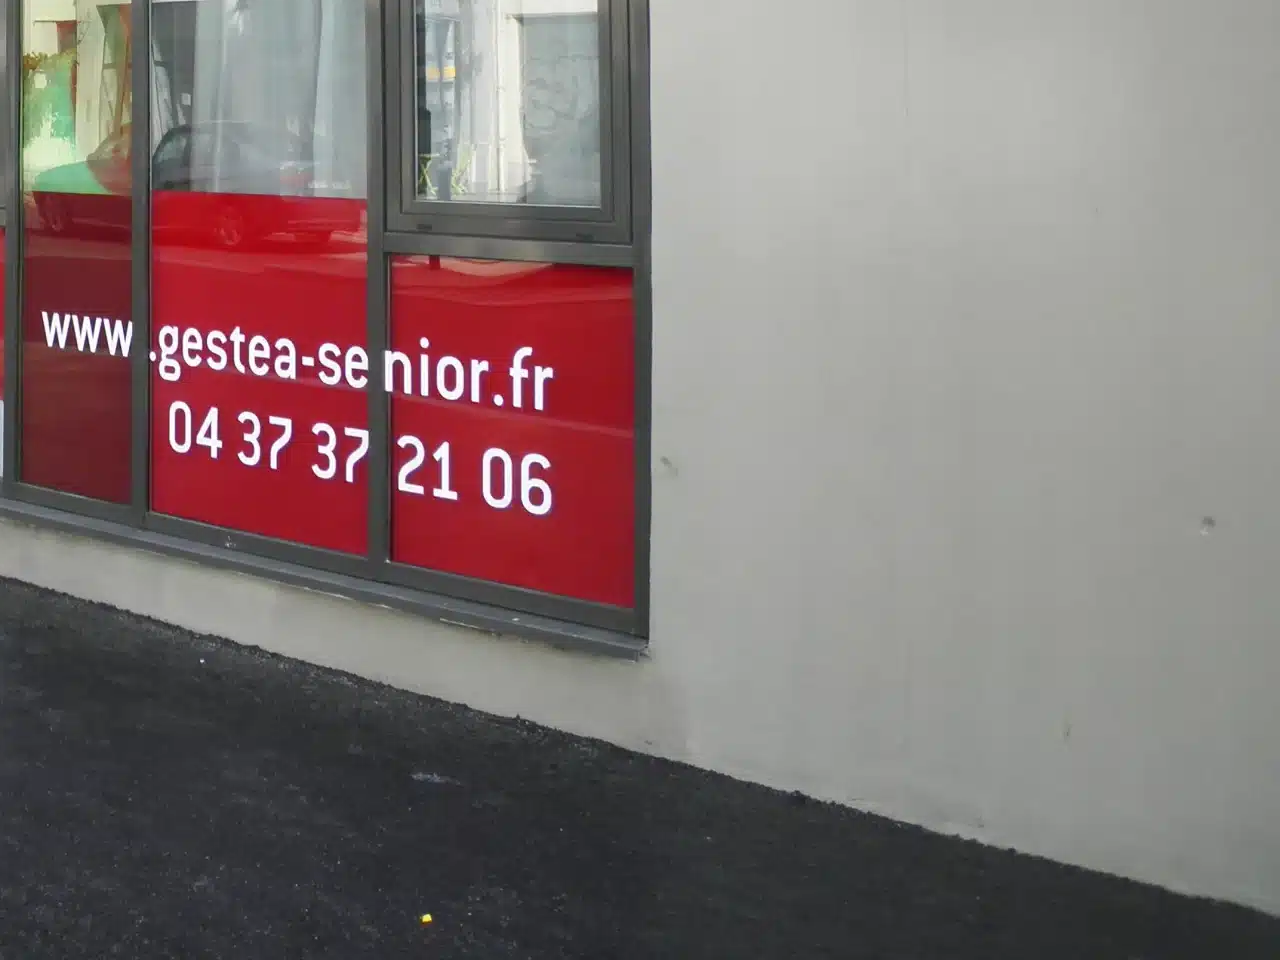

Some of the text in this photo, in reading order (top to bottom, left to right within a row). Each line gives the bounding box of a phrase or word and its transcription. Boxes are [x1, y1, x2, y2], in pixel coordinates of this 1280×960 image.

[41, 310, 554, 411] www.gestea-senior.fr
[168, 400, 553, 516] 04 37 37 21 06
